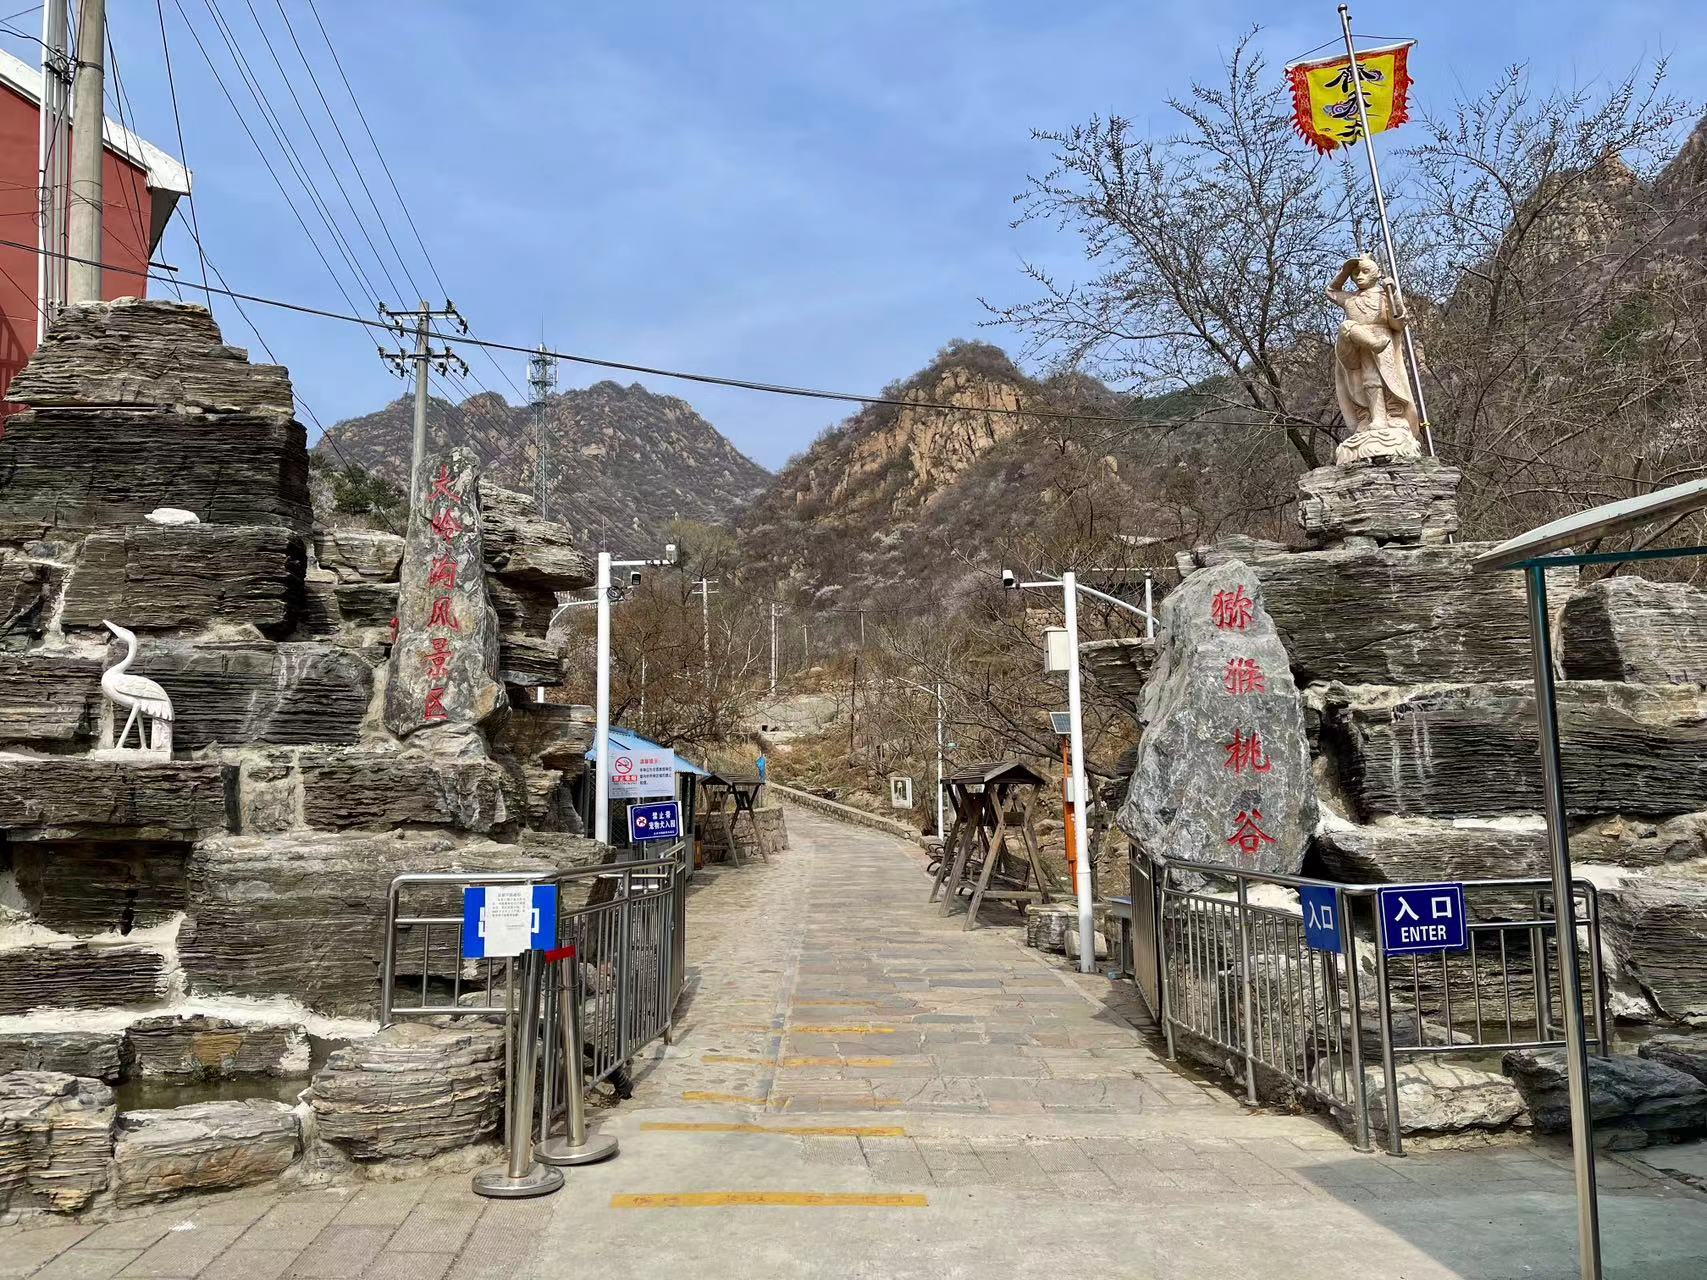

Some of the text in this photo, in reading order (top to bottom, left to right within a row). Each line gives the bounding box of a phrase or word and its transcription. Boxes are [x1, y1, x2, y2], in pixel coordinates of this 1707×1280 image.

[424, 464, 462, 720] 大岭沟风景区
[1211, 584, 1276, 853] 猕猴桃谷
[1308, 900, 1334, 930] 入口
[1394, 896, 1452, 922] 入口
[1401, 924, 1447, 943] ENTER
